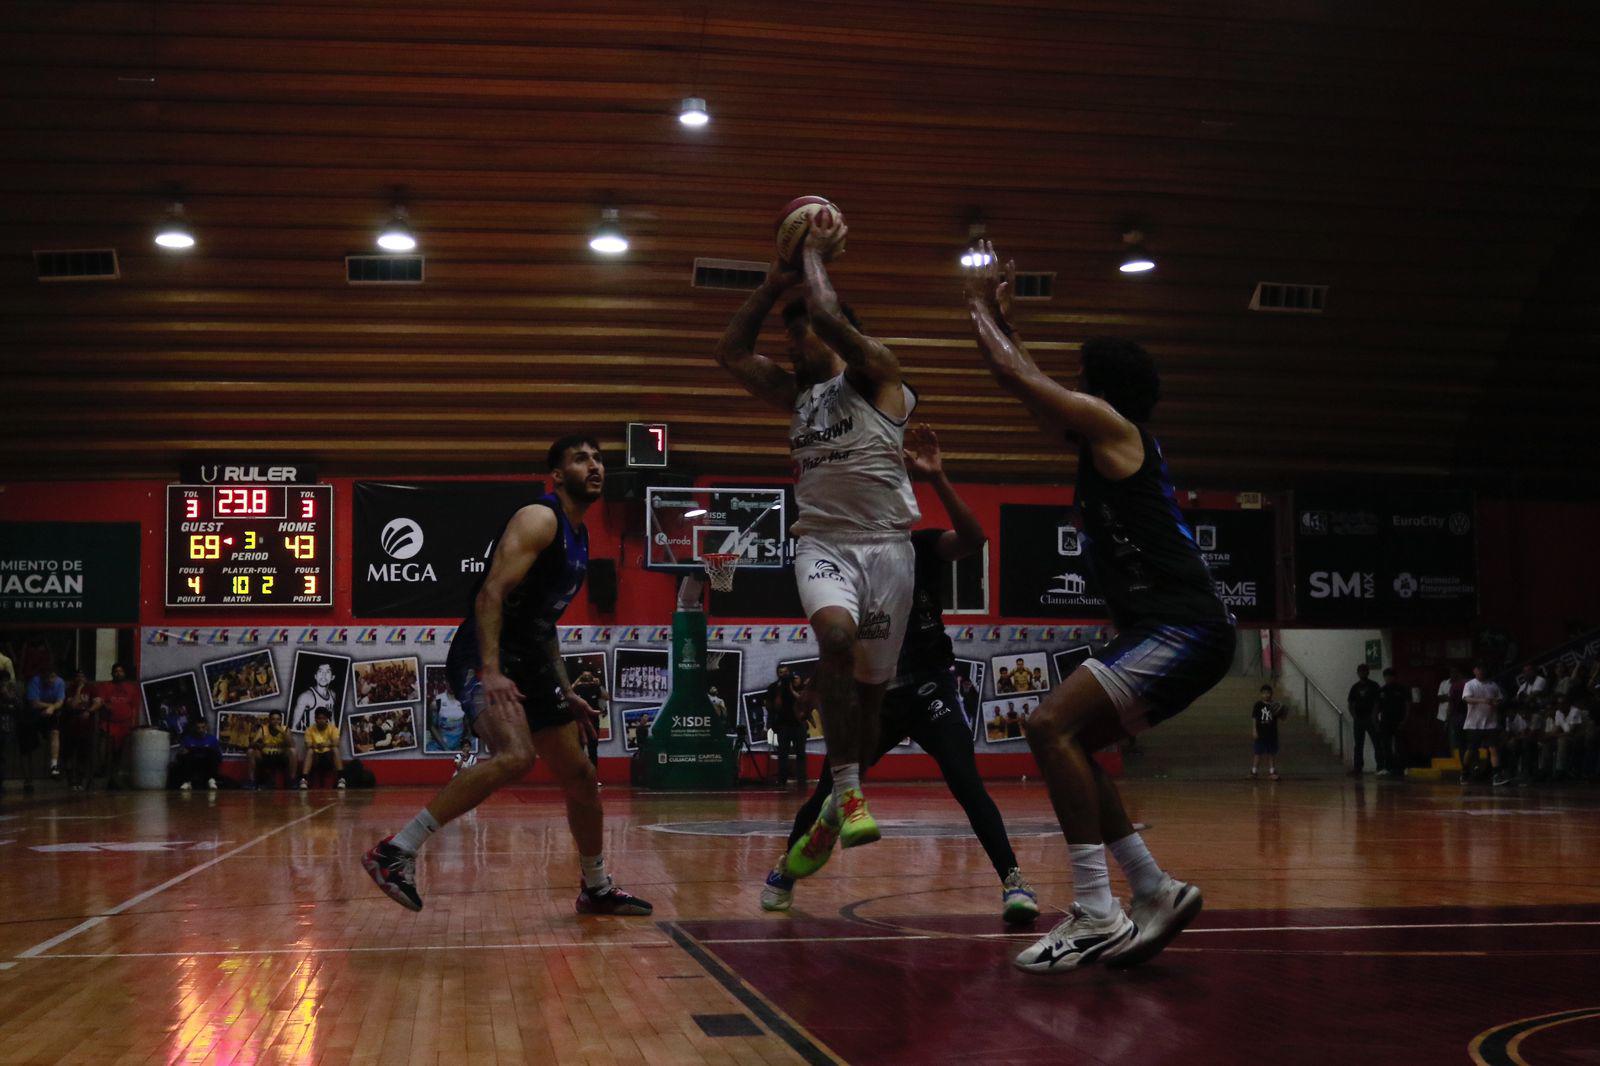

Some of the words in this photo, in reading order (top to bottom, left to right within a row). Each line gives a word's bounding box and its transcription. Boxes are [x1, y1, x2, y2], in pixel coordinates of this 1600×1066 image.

[648, 428, 662, 452] 7
[224, 466, 297, 482] RULER
[186, 499, 198, 518] 3
[218, 489, 267, 514] 23.8
[301, 499, 314, 518] 3
[180, 522, 224, 532] GUEST
[278, 522, 316, 532] HOME
[189, 535, 220, 559] 69
[244, 531, 256, 549] 3
[284, 535, 315, 559] 43
[62, 560, 83, 571] DE
[231, 552, 269, 561] PERIOD
[367, 563, 438, 582] MEGA
[187, 576, 200, 594] 4
[232, 576, 249, 594] 10
[262, 576, 274, 594] 2
[304, 576, 316, 594] 3
[1308, 571, 1362, 599] SM
[14, 600, 83, 609] BIENESTAR
[682, 716, 711, 727] ISDE
